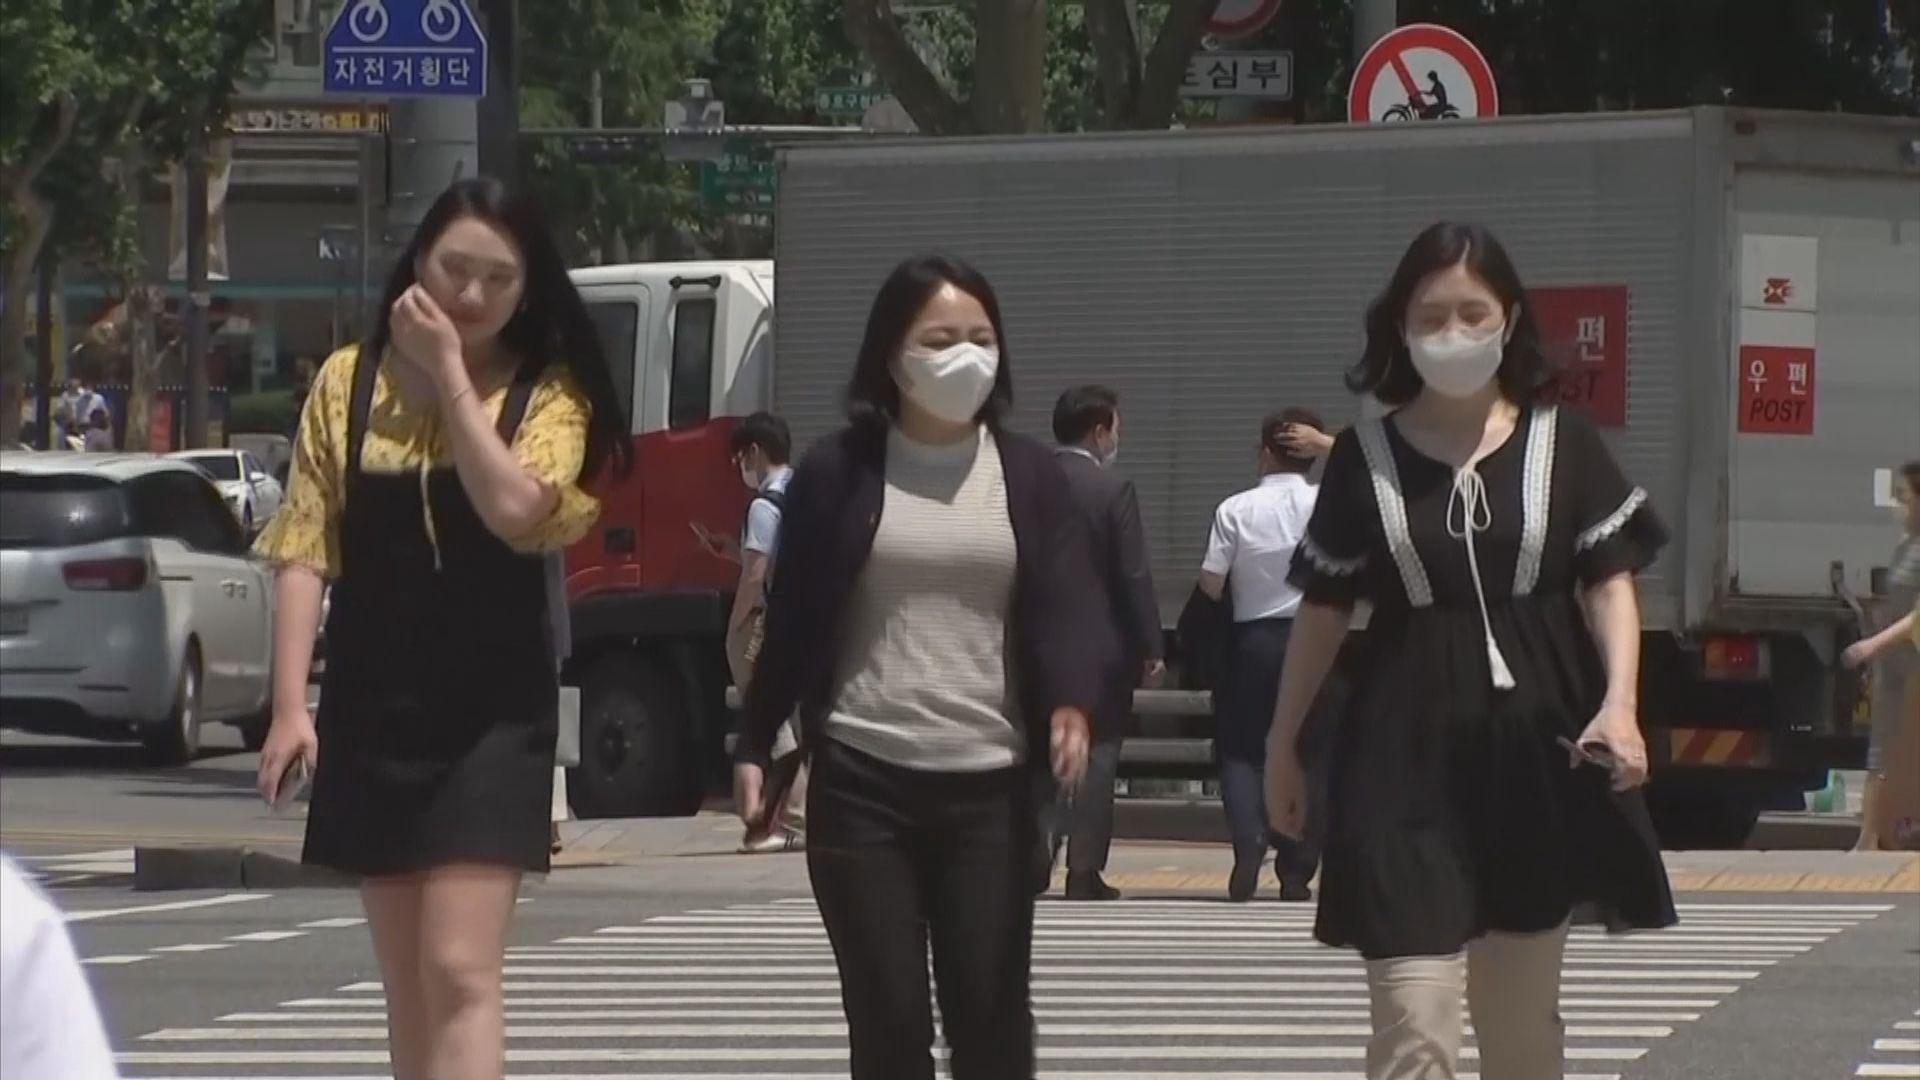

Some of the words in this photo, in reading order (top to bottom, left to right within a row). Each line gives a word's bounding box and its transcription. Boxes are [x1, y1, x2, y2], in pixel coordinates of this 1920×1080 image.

[334, 55, 470, 86] 자전거횡단
[1575, 314, 1606, 361] 편
[1749, 396, 1808, 424] POST
